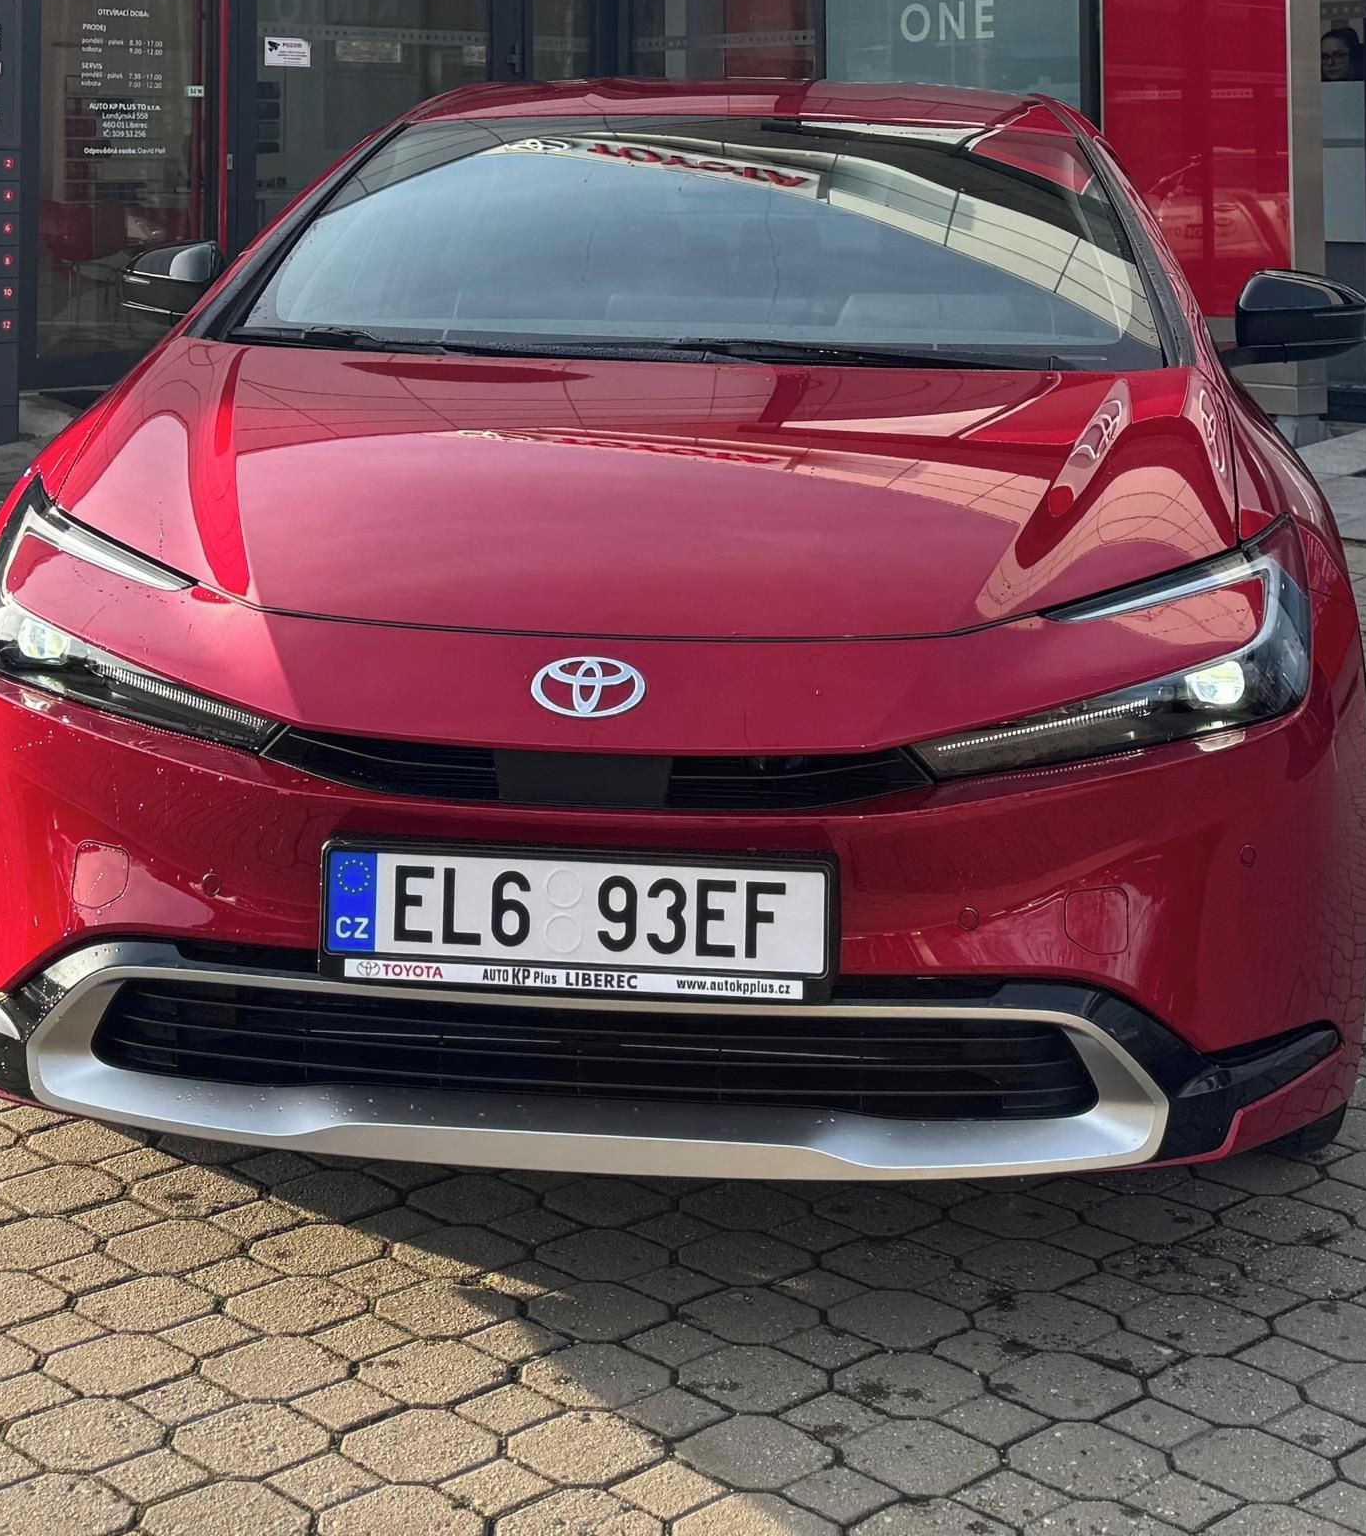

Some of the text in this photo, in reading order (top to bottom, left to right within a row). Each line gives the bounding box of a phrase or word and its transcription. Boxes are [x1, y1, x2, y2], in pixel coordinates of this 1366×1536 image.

[900, 0, 995, 42] ONE
[335, 917, 369, 940] CZ
[394, 865, 787, 959] EL6 93EF
[383, 964, 791, 995] TOYOTA AUTO KP Plus LIBEREC www.autokpplus.cz
